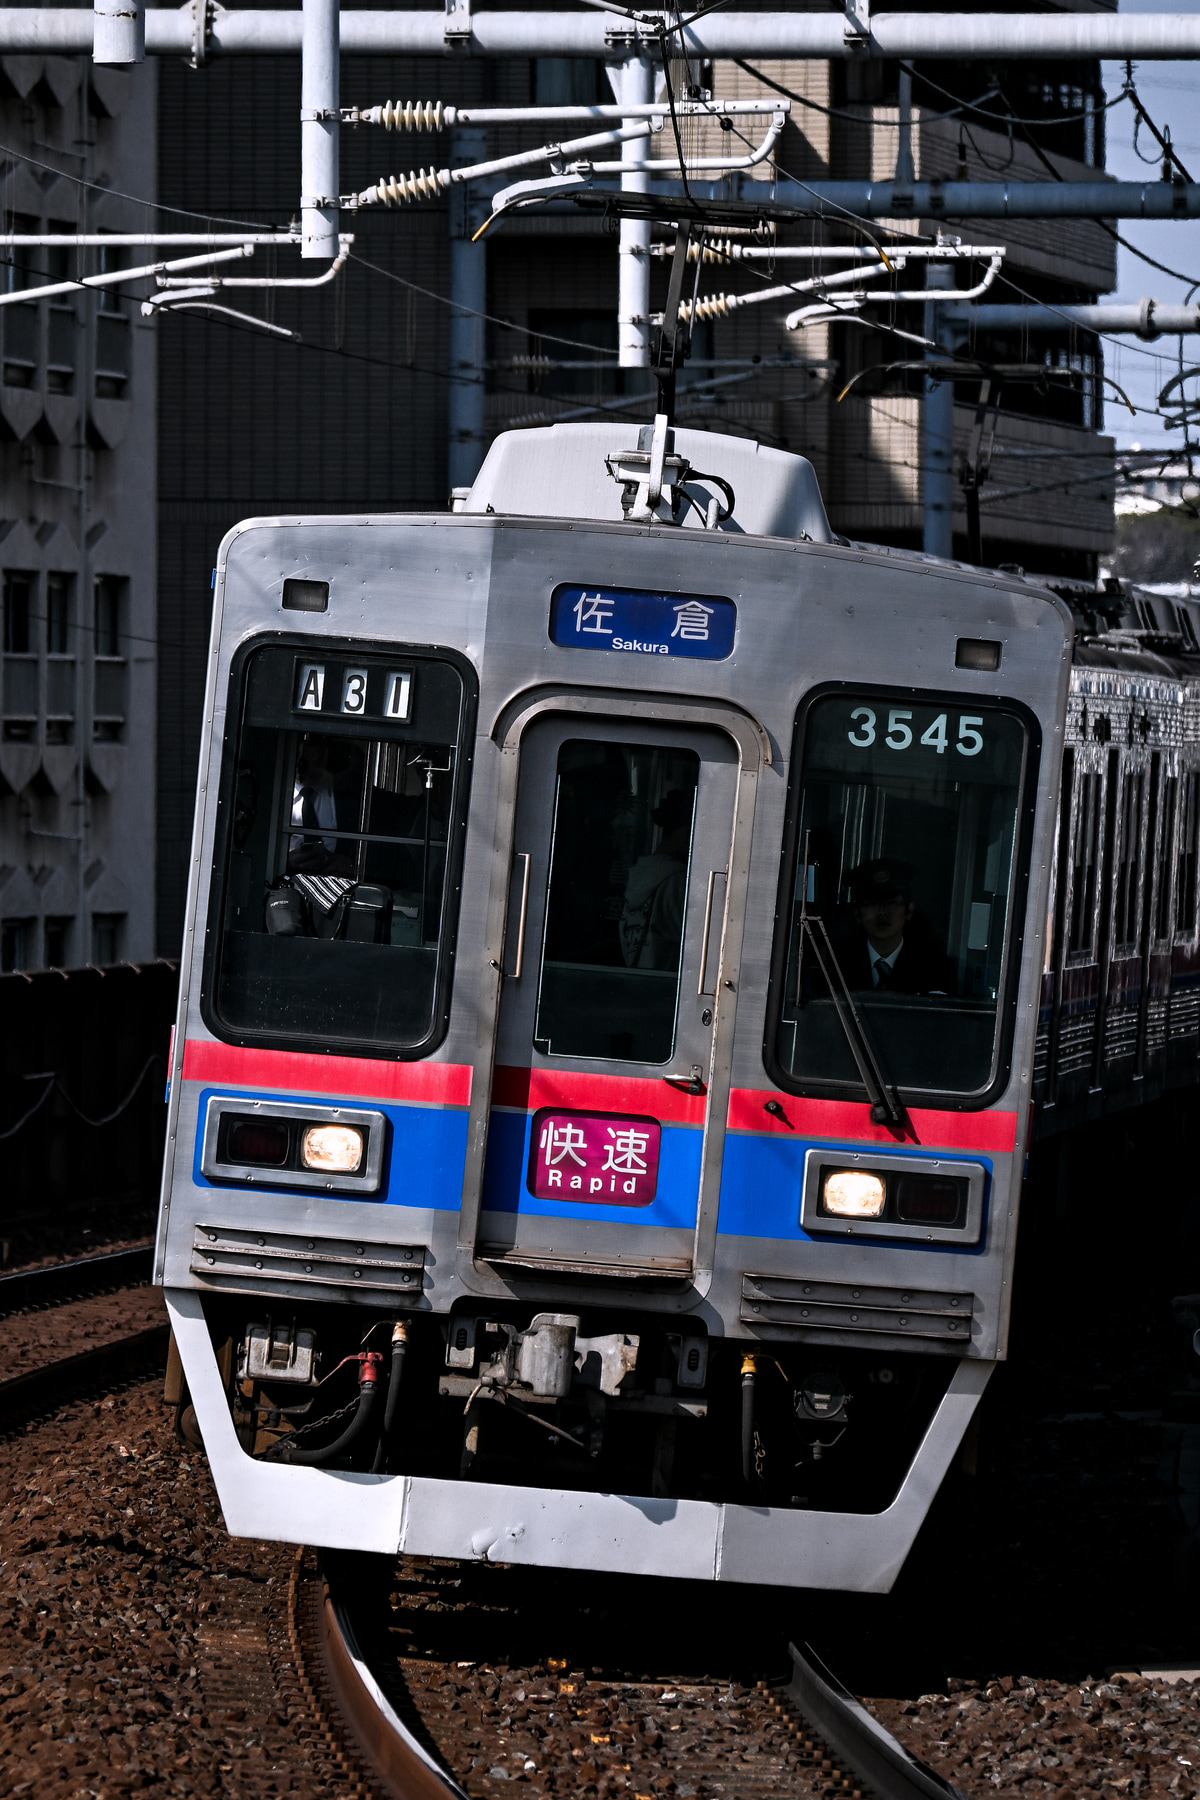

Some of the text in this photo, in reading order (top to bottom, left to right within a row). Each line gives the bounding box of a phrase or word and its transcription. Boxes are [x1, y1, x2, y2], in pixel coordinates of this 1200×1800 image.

[573, 592, 715, 641] 佐倉
[611, 637, 669, 654] Sakura
[848, 706, 984, 756] 3545
[540, 1121, 650, 1175] 快速
[548, 1169, 637, 1194] Rapid
